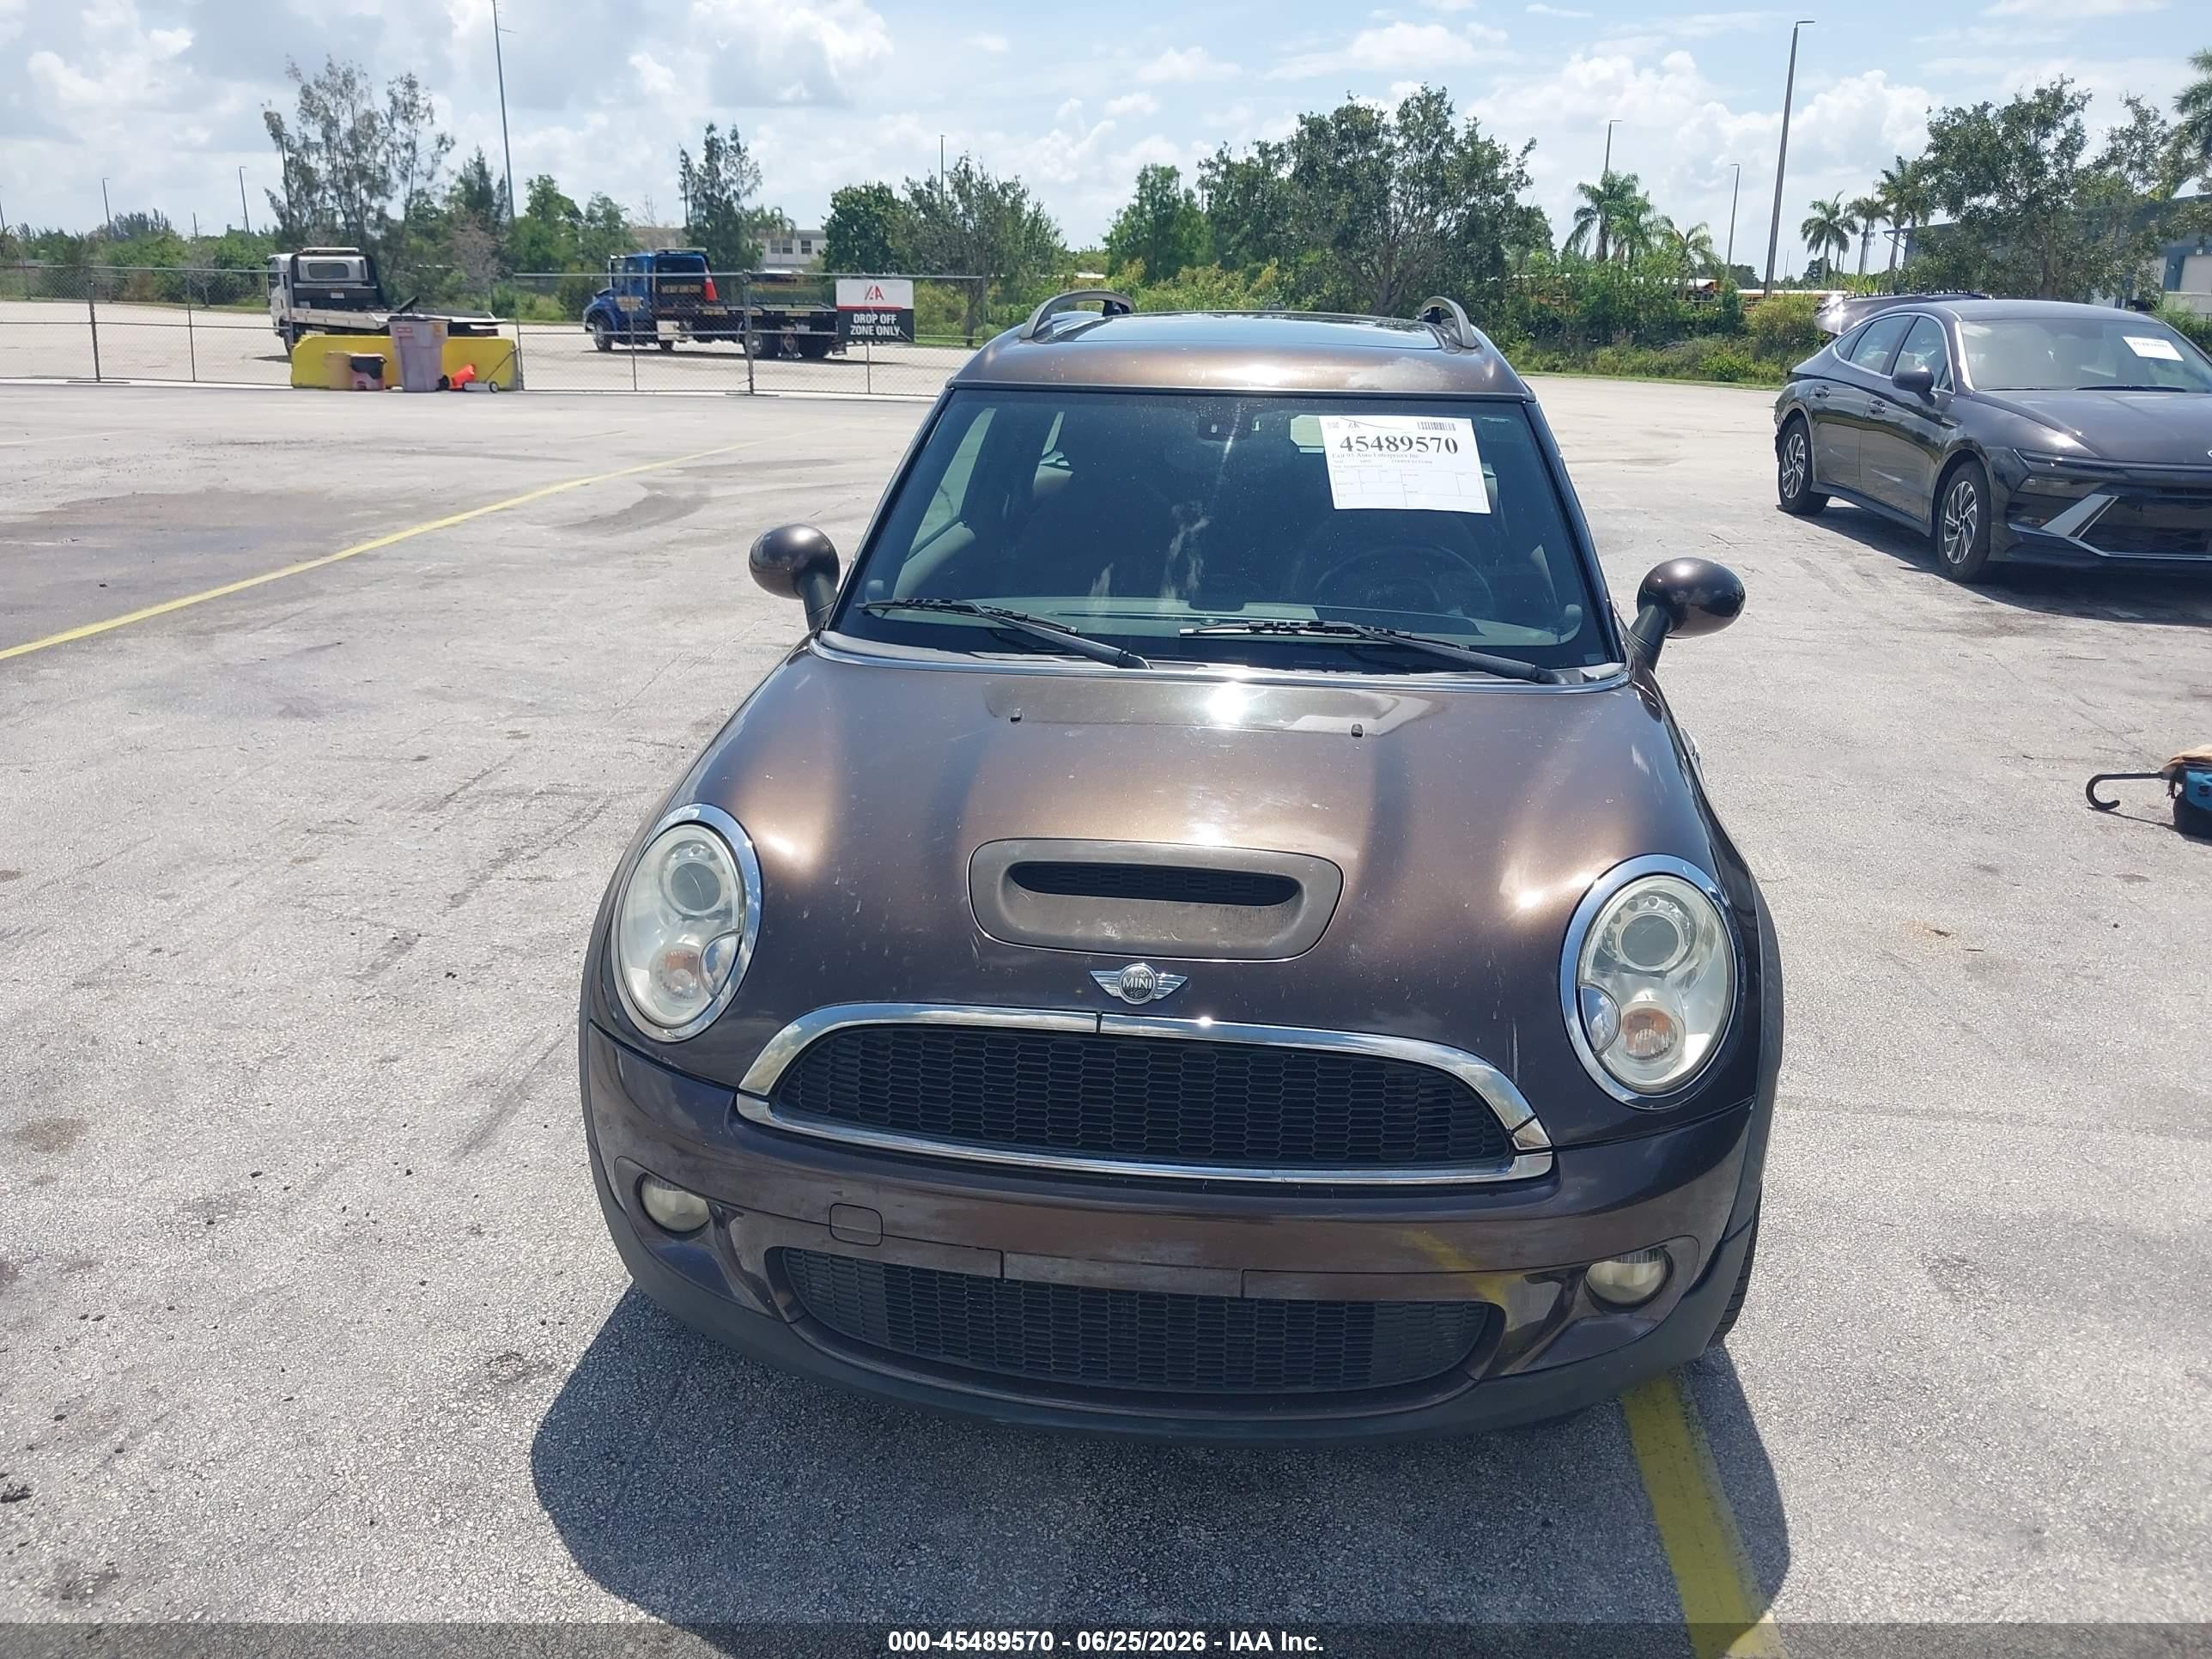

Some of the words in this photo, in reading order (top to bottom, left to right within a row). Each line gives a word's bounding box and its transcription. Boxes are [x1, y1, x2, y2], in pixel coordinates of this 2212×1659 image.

[853, 313, 878, 324] DROP
[879, 314, 896, 325] OFF
[850, 325, 874, 336] ZONE
[876, 325, 900, 336] ONLY
[1340, 435, 1458, 454] 45489570
[1122, 977, 1152, 989] MINI
